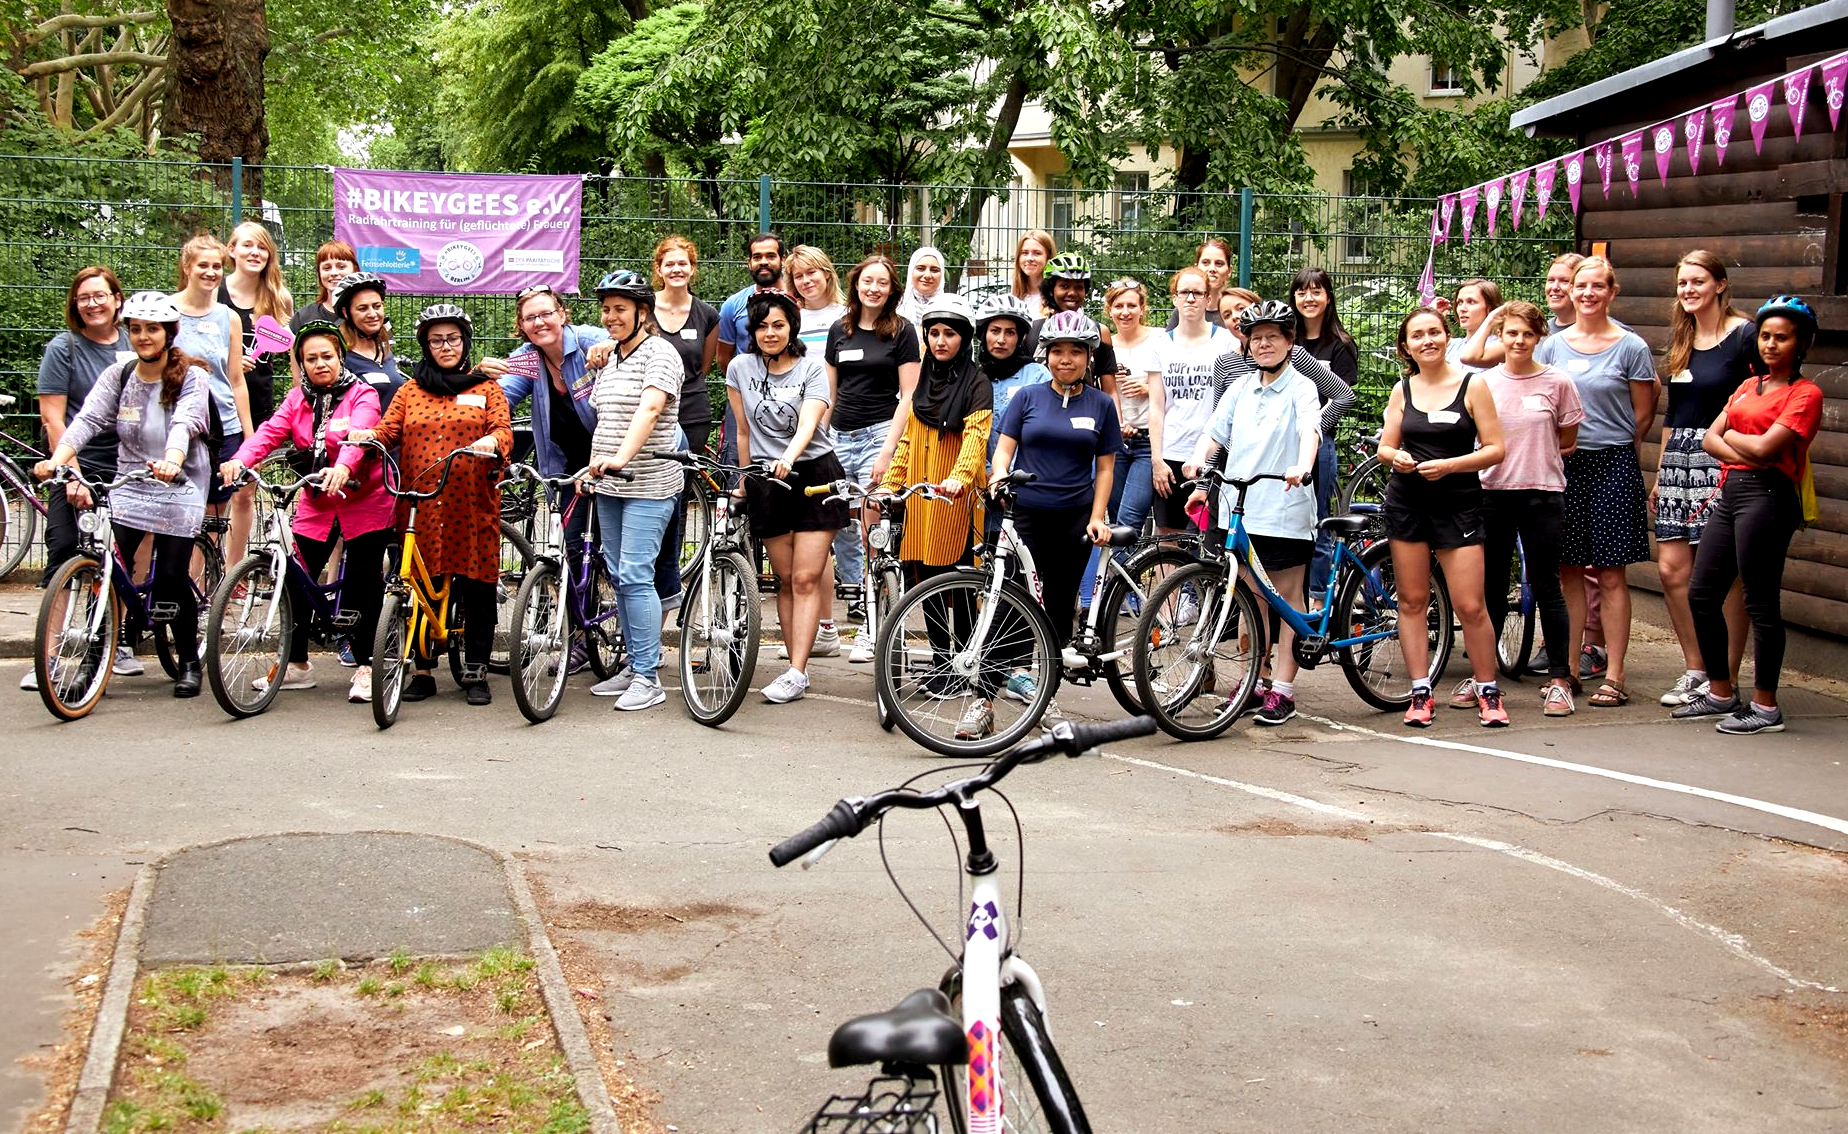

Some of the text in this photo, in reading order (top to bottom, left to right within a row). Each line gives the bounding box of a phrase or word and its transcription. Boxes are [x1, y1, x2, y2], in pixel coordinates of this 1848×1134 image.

[347, 187, 571, 216] #BIKEYGEES e.V.
[348, 213, 436, 231] Radfahrtraining
[440, 219, 456, 230] für
[533, 220, 570, 230] Frauen
[1164, 375, 1213, 387] OUR LOCA
[1172, 388, 1206, 400] PLANET
